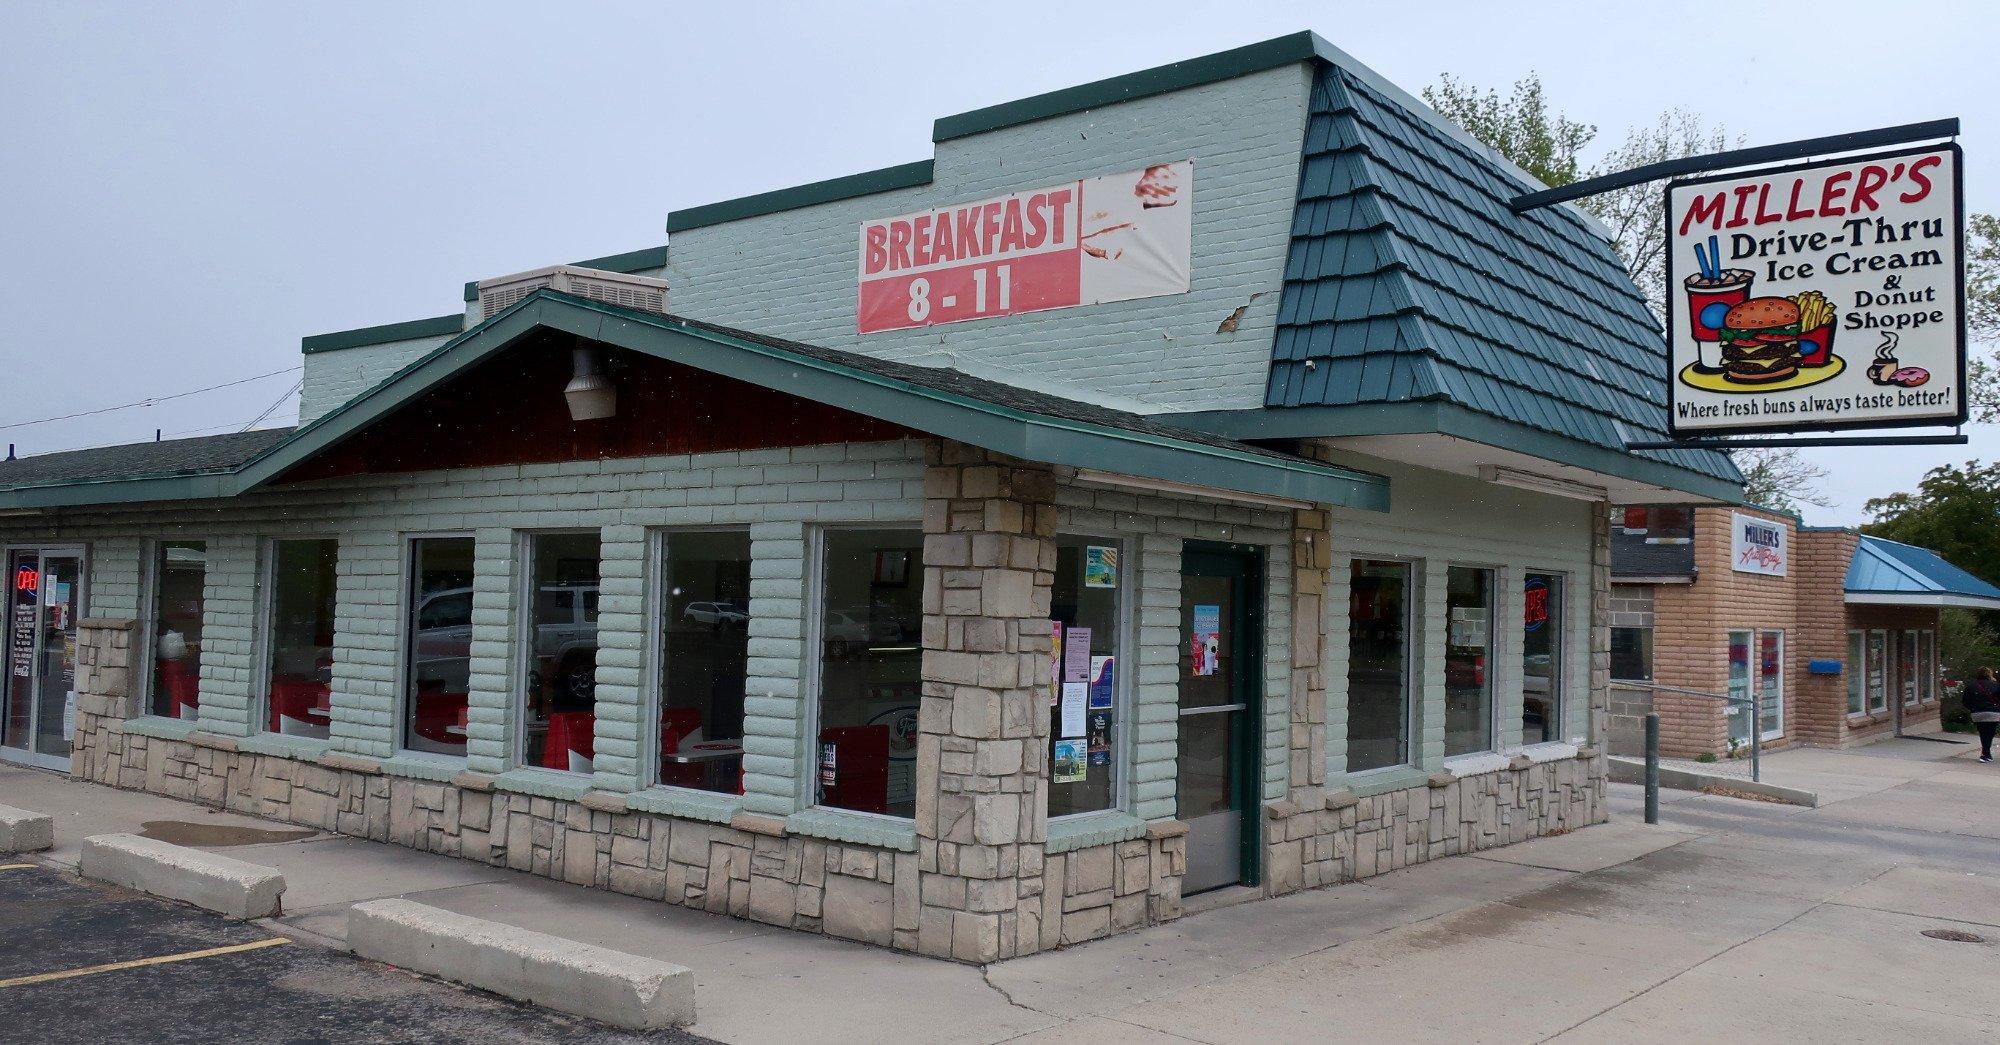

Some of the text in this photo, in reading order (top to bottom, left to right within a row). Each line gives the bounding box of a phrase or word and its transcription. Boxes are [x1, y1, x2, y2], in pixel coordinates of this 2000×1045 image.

[1679, 155, 1942, 236] MILLER'S
[865, 189, 1072, 275] BREAKFAST
[1731, 216, 1944, 260] Drive-Thru
[1767, 249, 1943, 282] Ice Cream
[1883, 274, 1901, 290] &
[907, 277, 931, 322] 8
[973, 265, 1011, 312] 11
[1855, 285, 1935, 308] Donut
[1844, 309, 1944, 331] Shoppe
[1677, 387, 1951, 419] Where fresh buns always taste better!
